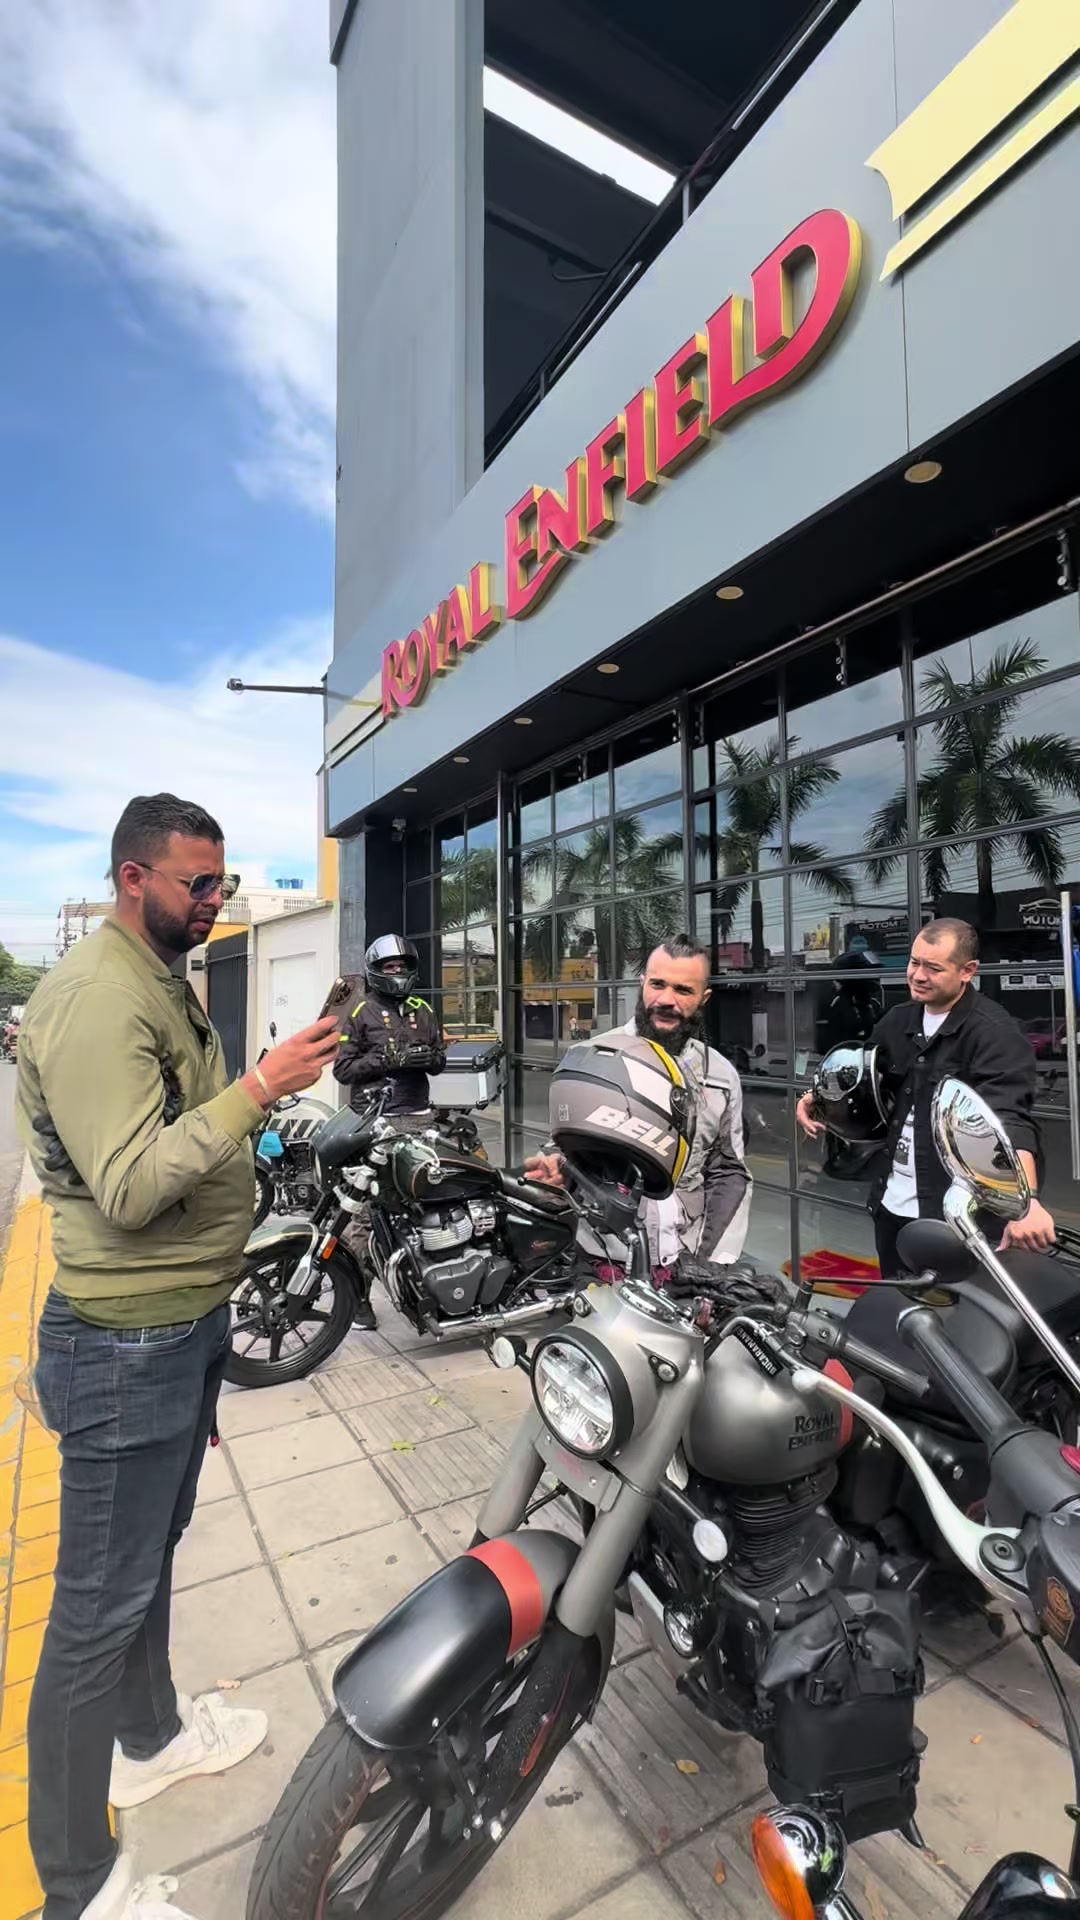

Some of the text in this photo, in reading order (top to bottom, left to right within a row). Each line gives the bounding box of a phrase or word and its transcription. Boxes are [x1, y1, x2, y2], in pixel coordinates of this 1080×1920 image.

[381, 208, 862, 717] ROYAL ENFIELD
[584, 1104, 676, 1157] BELL
